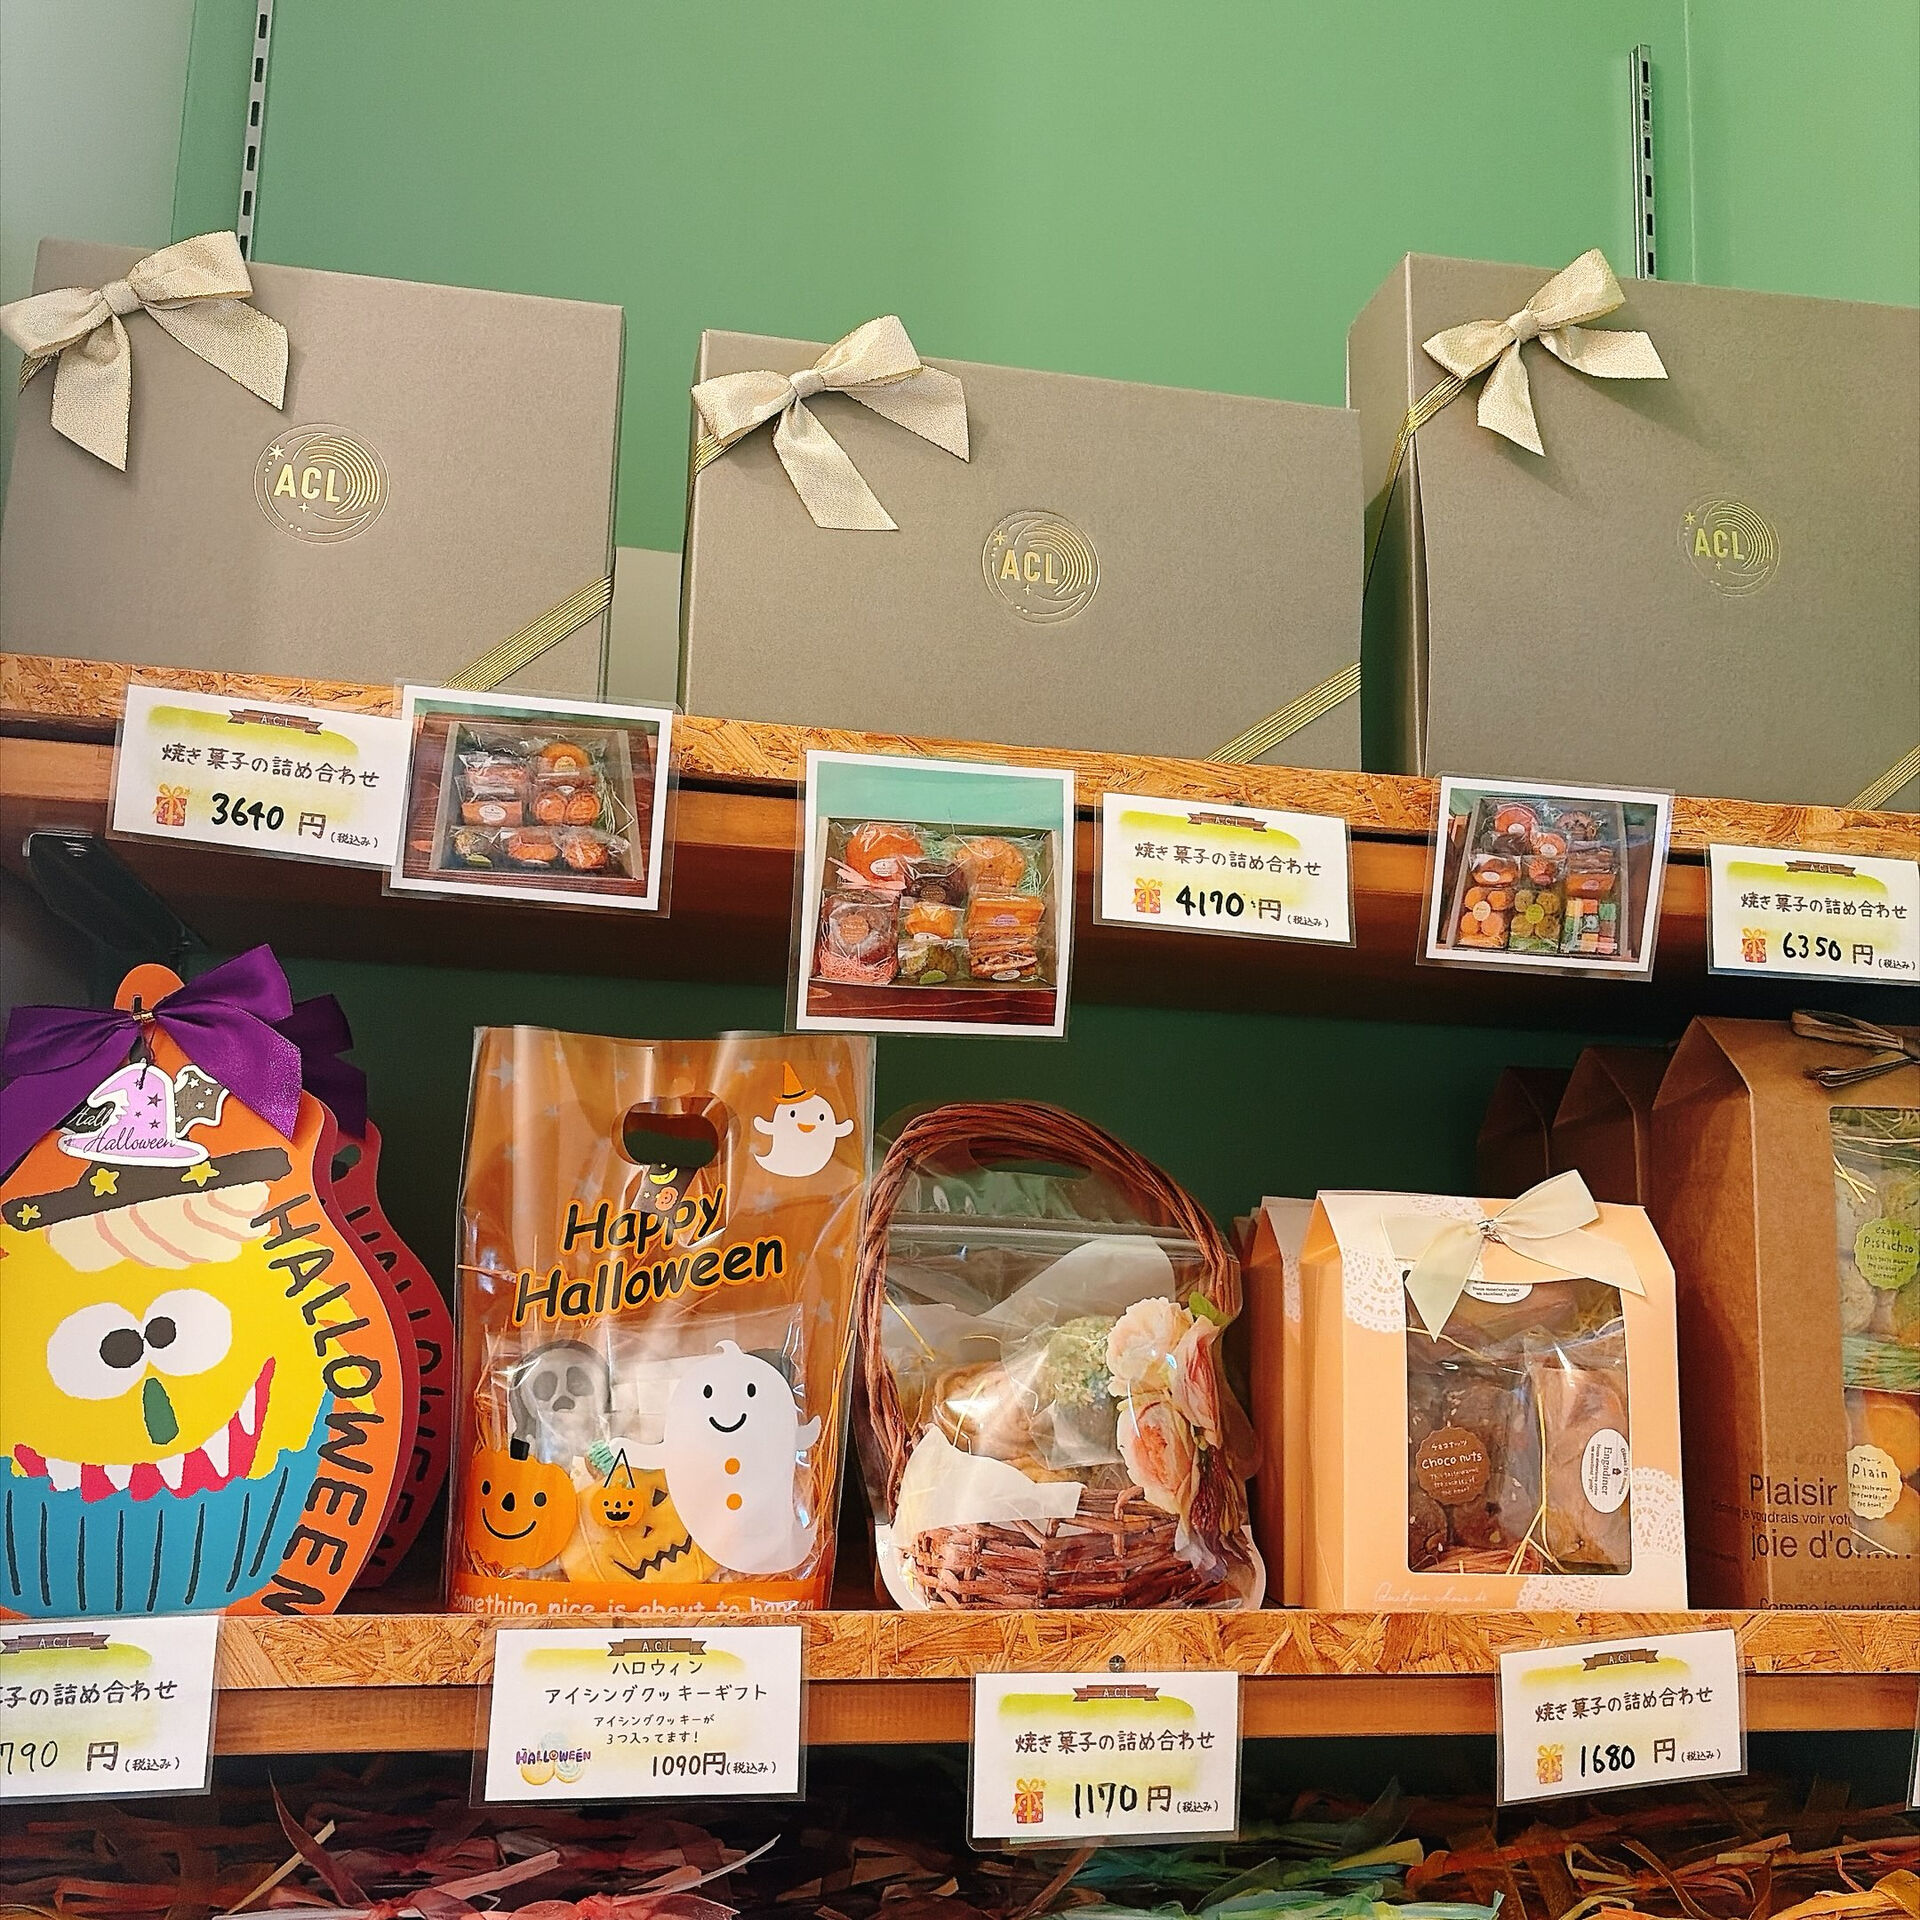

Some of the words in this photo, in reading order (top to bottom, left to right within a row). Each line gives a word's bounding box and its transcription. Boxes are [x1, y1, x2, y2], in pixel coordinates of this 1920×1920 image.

[273, 463, 341, 503] ACL
[1694, 528, 1745, 560] ACL
[1000, 549, 1058, 585] ACL
[161, 742, 380, 788] 焼き菓子の詰め合わせ
[211, 792, 285, 831] 3640
[1135, 842, 1321, 877] 焼き菓子の詰め合わせ
[1175, 885, 1244, 917] 4170
[1740, 892, 1908, 919] 焼き菓子の詰め合わせ
[1782, 932, 1842, 961] 6350
[84, 1126, 176, 1153] Halloween
[562, 1185, 724, 1255] Happy
[514, 1238, 784, 1324] Halloween
[250, 1193, 384, 1615] HALLOWEEN
[1460, 1451, 1483, 1462] nuts
[1750, 1473, 1838, 1506] Plaisir
[1750, 1510, 1799, 1524] voudrais
[1802, 1512, 1825, 1525] voir
[1751, 1526, 1797, 1561] joie
[548, 1598, 595, 1613] nice
[608, 1599, 626, 1613] is
[638, 1599, 704, 1613] about
[717, 1600, 739, 1613] to
[612, 1659, 703, 1676] ハロウィン
[0, 1679, 178, 1709] 子の詰め合わせ
[544, 1683, 767, 1705] アイシングクッキーギフト
[1535, 1686, 1713, 1723] 焼き菓子の詰め合わせ
[593, 1714, 715, 1728] アイシングクッキーが
[0, 1740, 59, 1775] 790
[515, 1748, 591, 1765] HALLOWEEN
[1015, 1729, 1216, 1755] 焼き菓子の詰め合わせ
[1580, 1744, 1636, 1777] 1680
[1074, 1782, 1138, 1819] 1170
